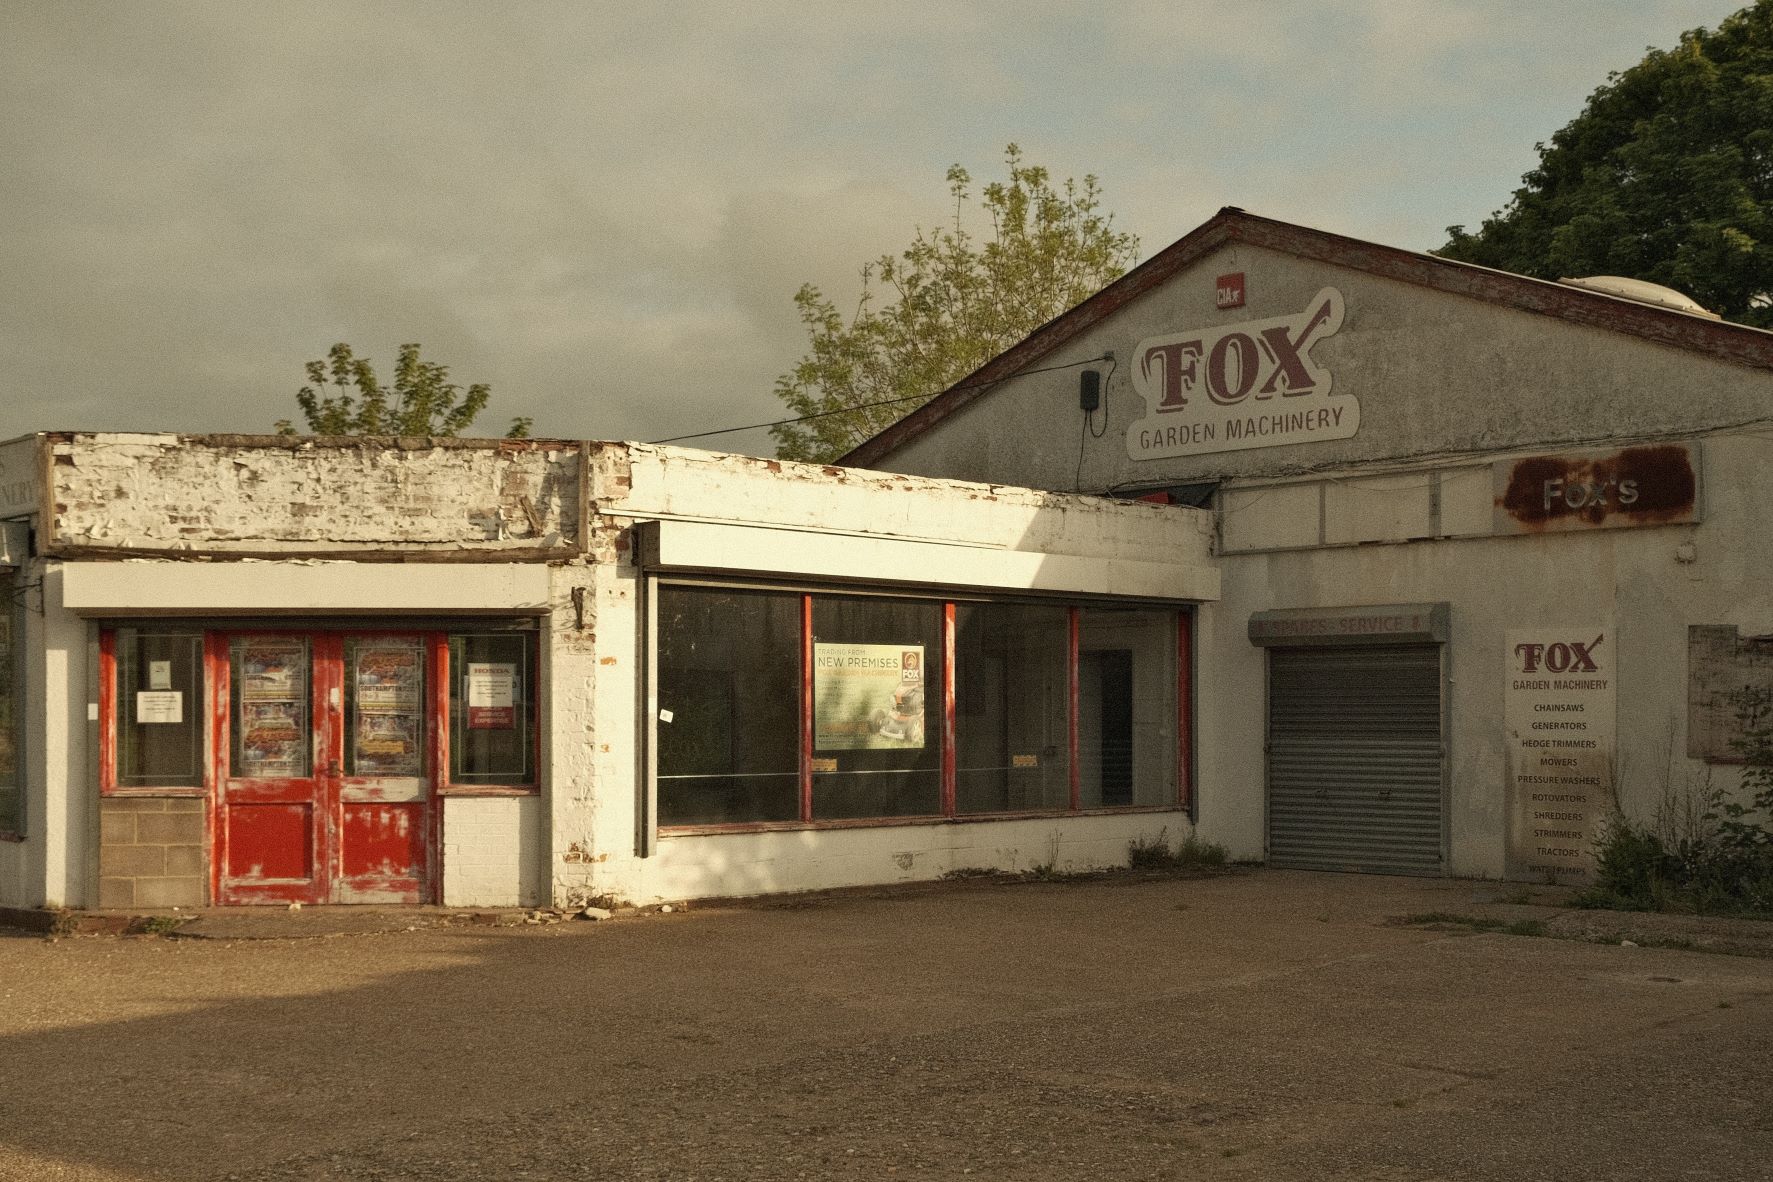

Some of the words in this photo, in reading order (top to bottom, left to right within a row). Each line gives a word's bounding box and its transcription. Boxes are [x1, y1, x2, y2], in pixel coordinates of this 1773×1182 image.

[1141, 299, 1332, 413] FOX
[1140, 423, 1215, 449] GARDEN
[1226, 406, 1344, 440] MACHINERY
[1339, 616, 1402, 633] SERVICE
[1515, 633, 1604, 673] FOX
[818, 657, 844, 667] NEW
[847, 658, 899, 668] PREMISES
[903, 669, 919, 679] FOX
[1513, 680, 1549, 690] GARDEN
[1554, 680, 1608, 690] MACHINERY
[1534, 704, 1585, 712] CHAINSAWS
[1531, 722, 1587, 730] GENERATORS
[1522, 740, 1551, 748] HEDGE
[1552, 740, 1597, 748] TRIMMERS
[1540, 758, 1578, 767] MOWERS
[1517, 775, 1559, 784] PRESSURE
[1560, 777, 1601, 785] WASHERS
[1532, 793, 1587, 803] ROTOVATORS
[1534, 811, 1583, 821] SHREDDERS
[1534, 829, 1583, 840] STRIMMERS
[1537, 847, 1580, 857] TRACTORS
